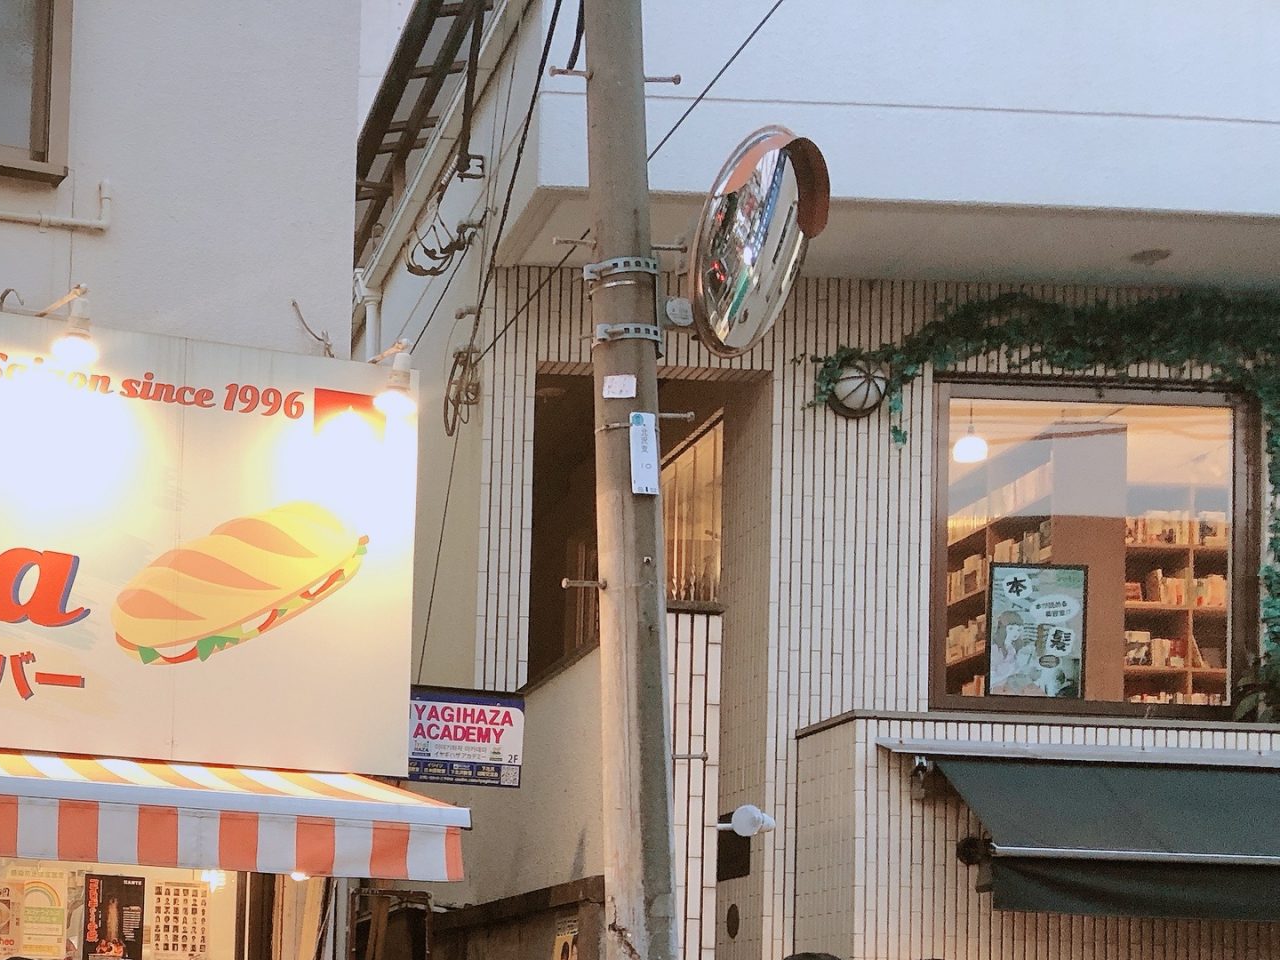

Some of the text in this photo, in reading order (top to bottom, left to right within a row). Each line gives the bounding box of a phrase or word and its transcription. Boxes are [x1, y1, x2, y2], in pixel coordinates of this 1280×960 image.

[120, 371, 217, 408] since
[223, 382, 306, 420] 1996
[1006, 576, 1027, 597] 本
[414, 703, 514, 727] YAGIHAZA
[412, 722, 505, 744] ACADEMY
[507, 754, 519, 764] 2F
